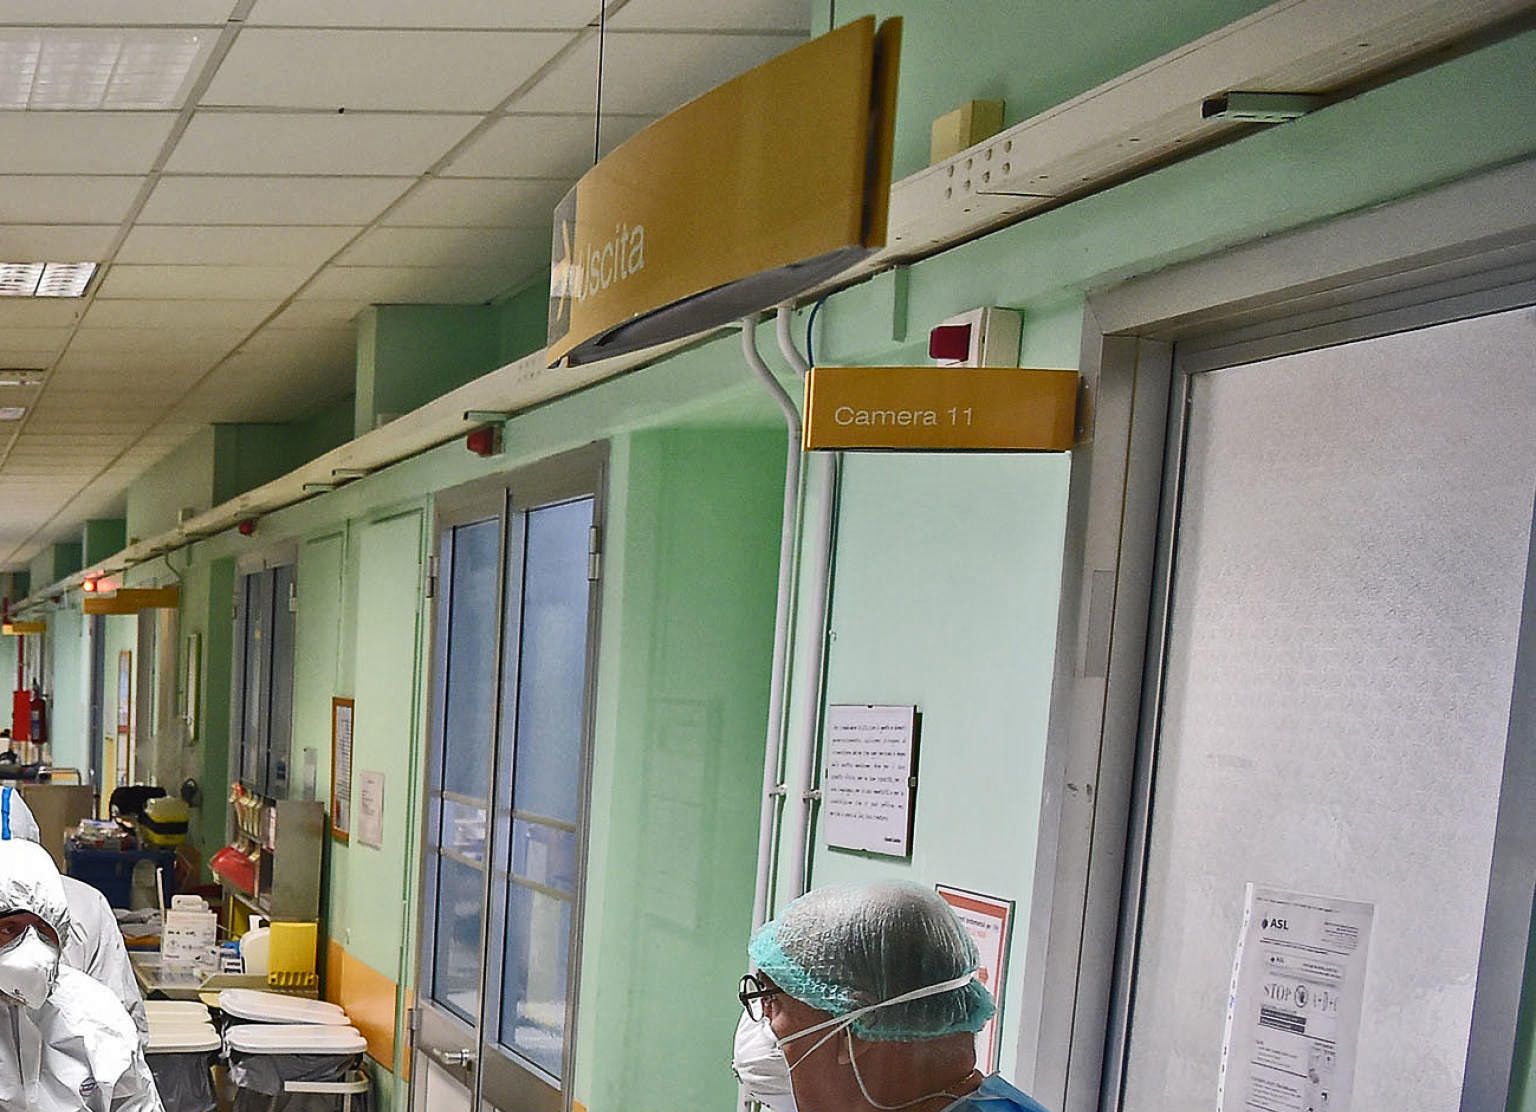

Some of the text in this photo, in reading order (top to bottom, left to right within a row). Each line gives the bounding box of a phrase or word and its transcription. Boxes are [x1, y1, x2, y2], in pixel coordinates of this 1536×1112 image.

[579, 222, 646, 304] Uscita
[834, 405, 973, 426] Camera 11
[1270, 918, 1289, 930] ASL
